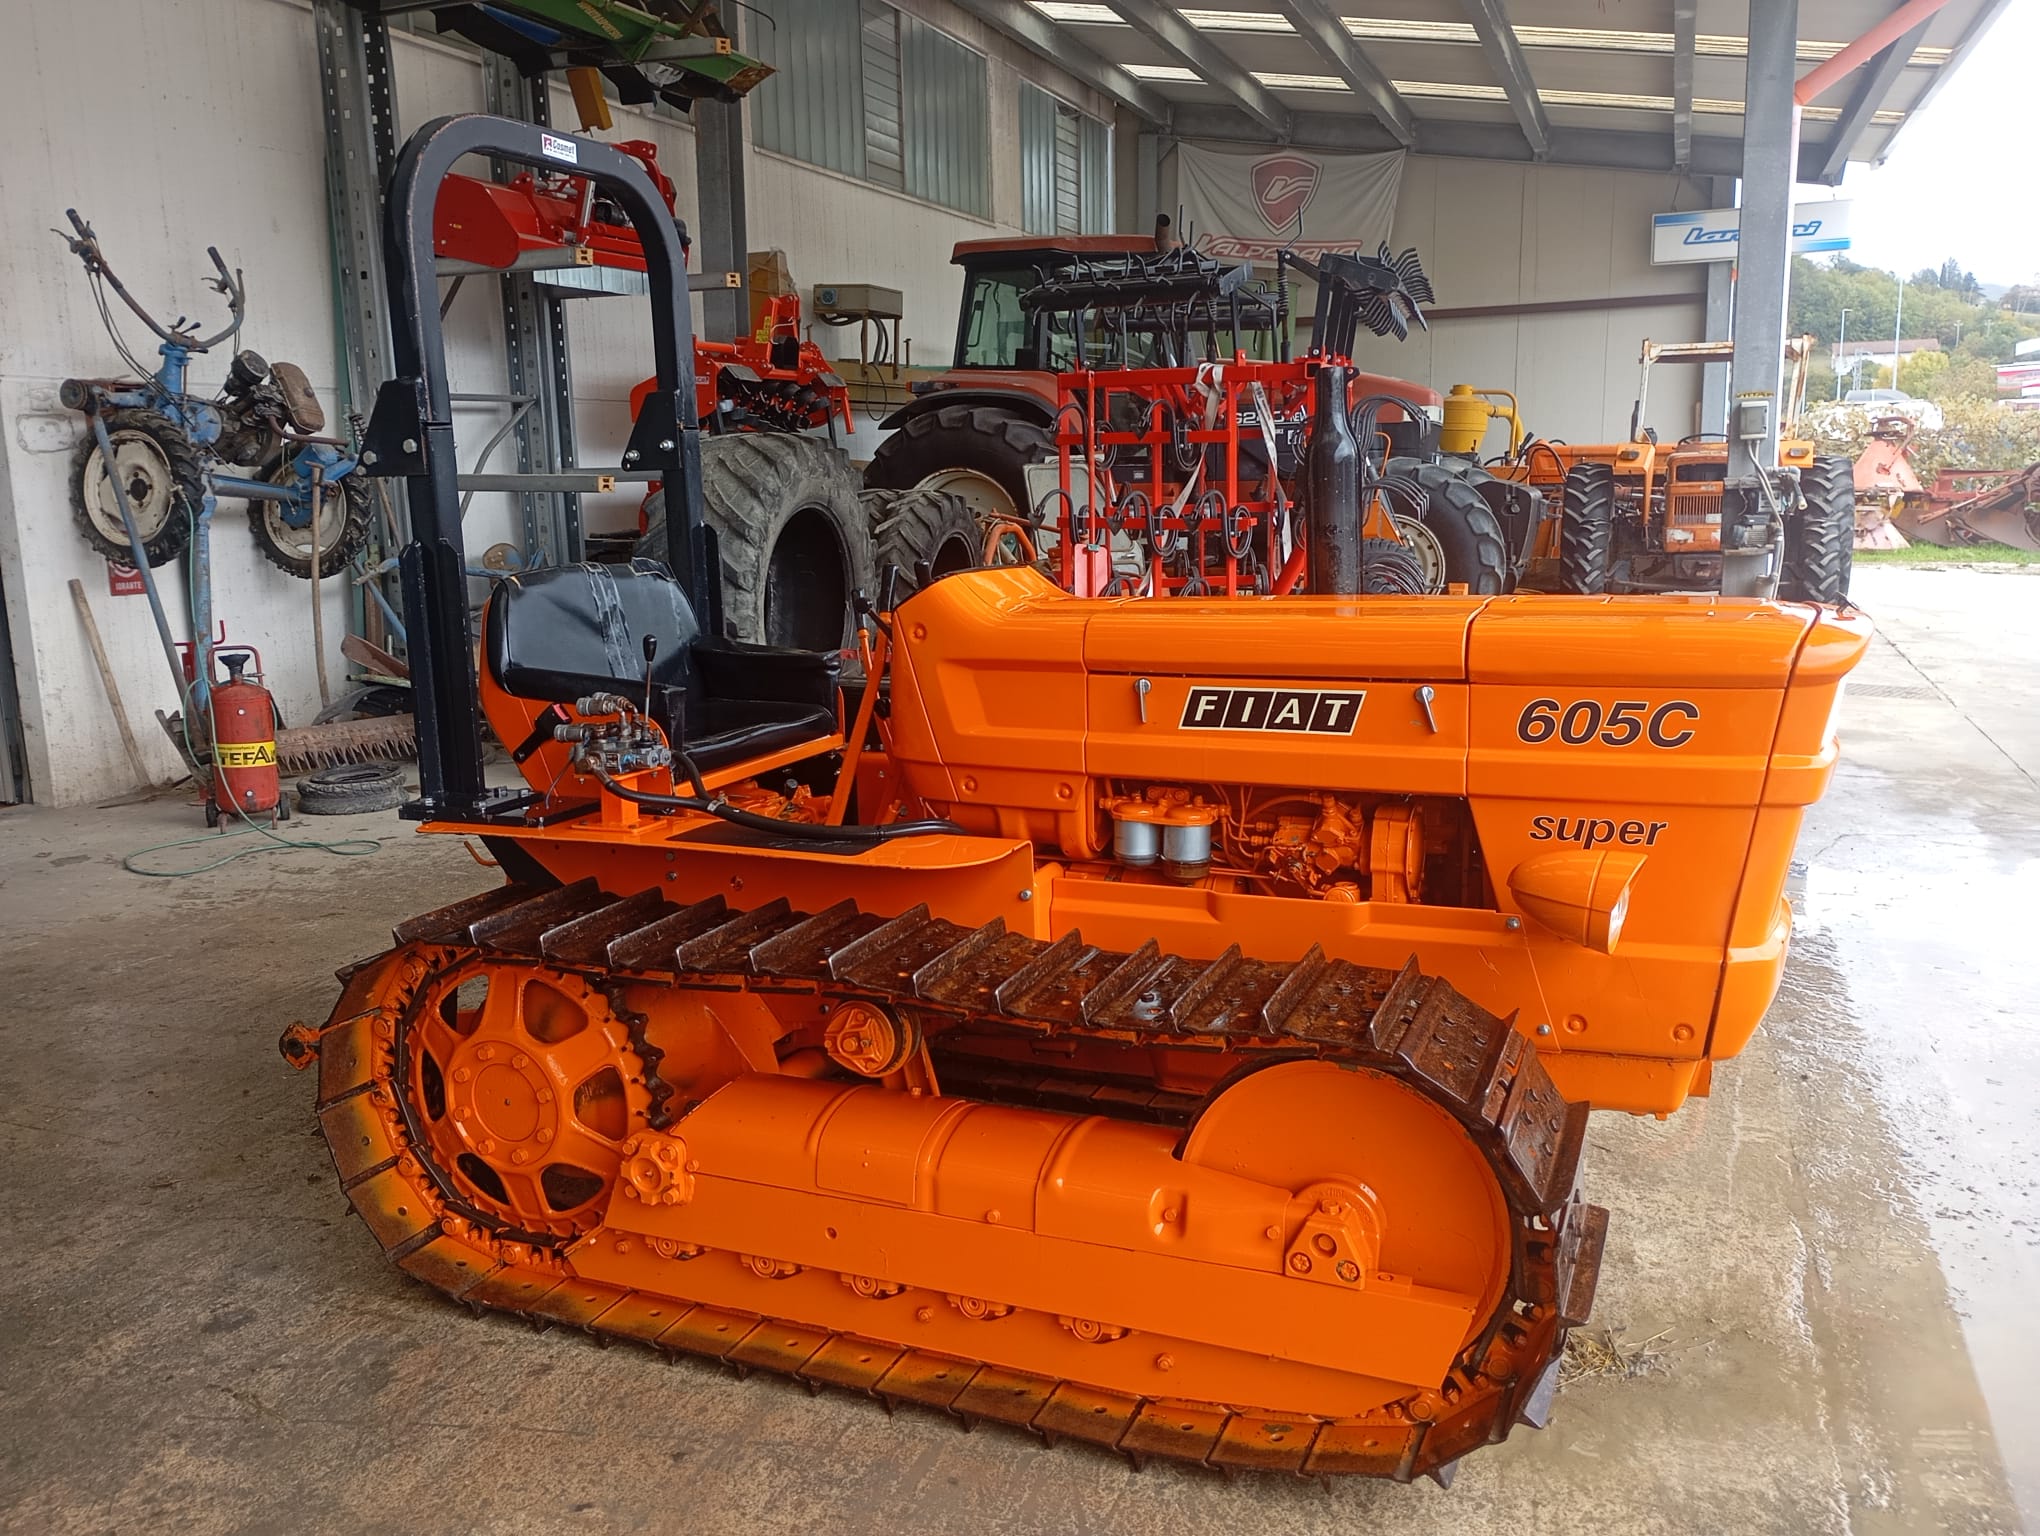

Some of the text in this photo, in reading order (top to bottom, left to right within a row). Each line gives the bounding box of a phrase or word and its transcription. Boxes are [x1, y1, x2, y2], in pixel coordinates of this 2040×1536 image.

[115, 581, 143, 590] IDRANTE
[1194, 696, 1350, 727] FIAT
[1517, 698, 1700, 749] 605C
[1529, 815, 1669, 850] super
